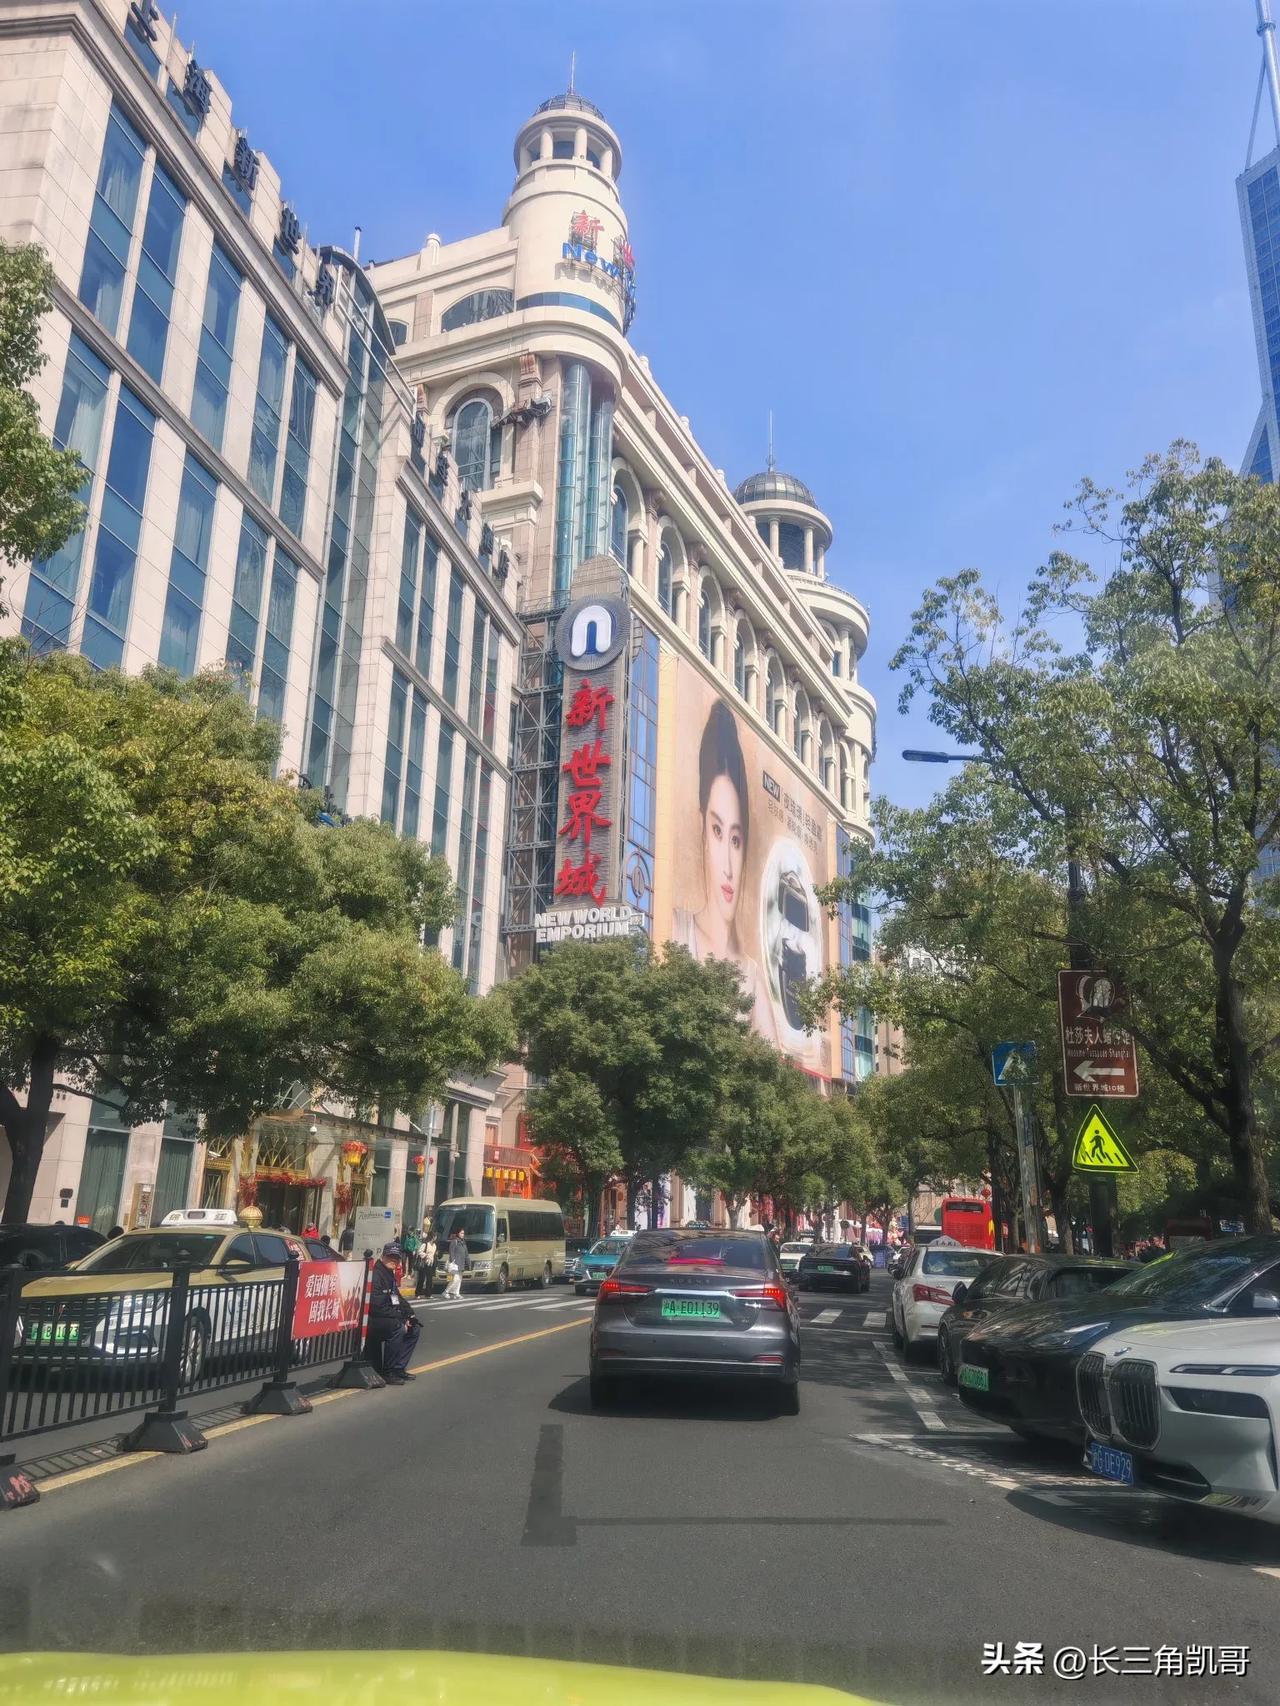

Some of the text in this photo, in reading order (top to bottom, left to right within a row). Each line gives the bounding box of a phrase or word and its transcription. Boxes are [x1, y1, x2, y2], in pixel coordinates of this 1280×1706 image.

[556, 678, 615, 906] 新世界城
[763, 773, 780, 800] NEW
[536, 921, 630, 943] EMPORIUM
